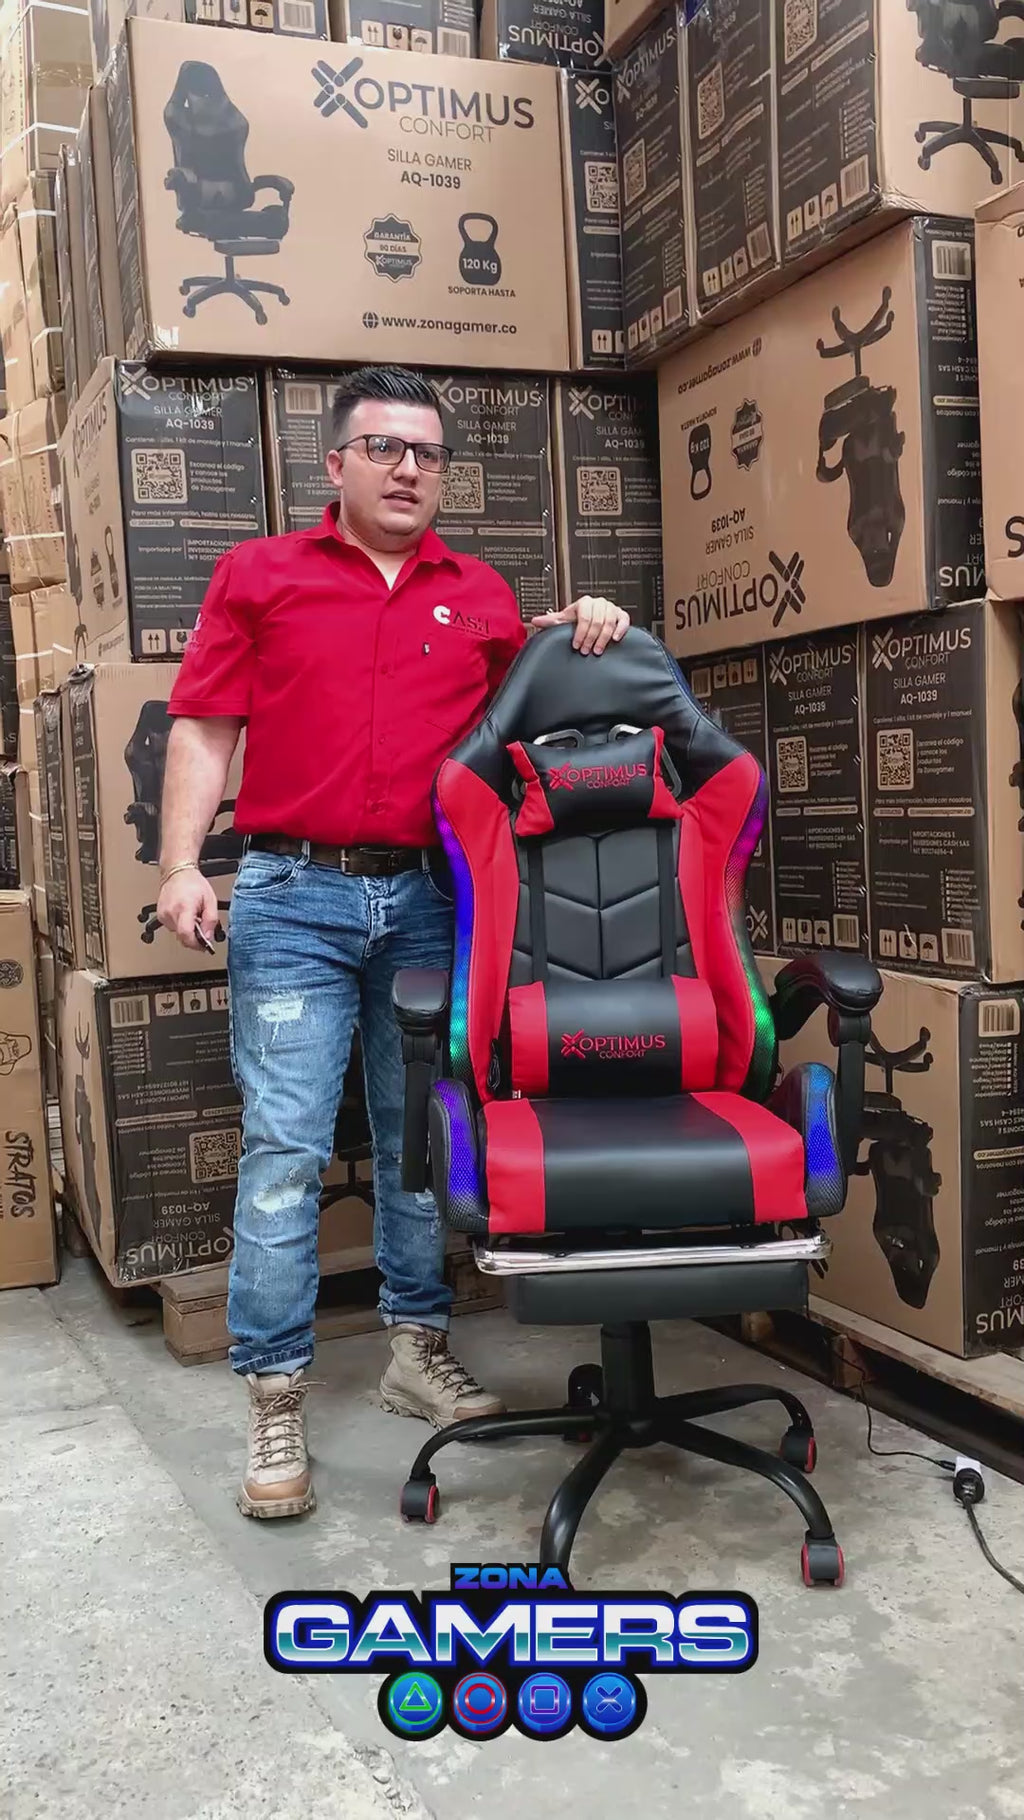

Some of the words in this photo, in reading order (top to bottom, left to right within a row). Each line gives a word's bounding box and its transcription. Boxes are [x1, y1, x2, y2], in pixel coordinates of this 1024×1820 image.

[507, 24, 599, 57] OPTIMUS
[354, 77, 535, 129] OPTIMUS
[399, 115, 496, 143] CONFORT
[387, 148, 422, 166] SILLA
[424, 152, 473, 172] GAMER
[400, 171, 461, 190] AQ-1039
[463, 257, 481, 270] 120
[482, 260, 498, 275] Kg
[447, 285, 488, 297] SOPORTA
[488, 287, 516, 298] HASTA
[381, 315, 518, 335] www.zonagamer.co
[141, 375, 249, 393] OPTIMUS
[447, 386, 541, 407] OPTIMUS
[153, 405, 181, 415] SILLA
[184, 406, 223, 418] GMER
[470, 404, 521, 416] CONFORT
[165, 418, 215, 430] AQ-1039
[456, 419, 481, 430] SILLA
[482, 420, 517, 431] GAMER
[466, 433, 510, 445] AQ-1039
[711, 507, 746, 534] AQ-1039
[733, 525, 755, 544] SILLA
[705, 534, 733, 555] GAMER
[695, 560, 751, 593] CONFORT
[674, 572, 779, 631] OPTIMUS
[887, 627, 972, 659] OPTIMUS
[781, 644, 852, 675] OPTIMUS
[904, 651, 951, 670] CONFORT
[893, 677, 913, 689] SILLA
[914, 672, 946, 687] GAMER
[788, 691, 805, 702] SILLA
[805, 685, 832, 699] GAMER
[900, 689, 938, 705] AQ-1039
[794, 701, 827, 716] AQ-1039
[566, 763, 648, 782] OPTIMUS
[586, 778, 631, 789] CONFORT
[579, 1034, 666, 1052] OPTIMUS
[598, 1049, 647, 1060] CONFORT
[3, 1130, 37, 1218] STRATOS
[161, 1200, 211, 1216] AQ-1039
[153, 1216, 192, 1229] GAMER
[193, 1212, 221, 1223] SILLA
[150, 1230, 206, 1244] CONFORT
[126, 1235, 231, 1266] OPTIMUS
